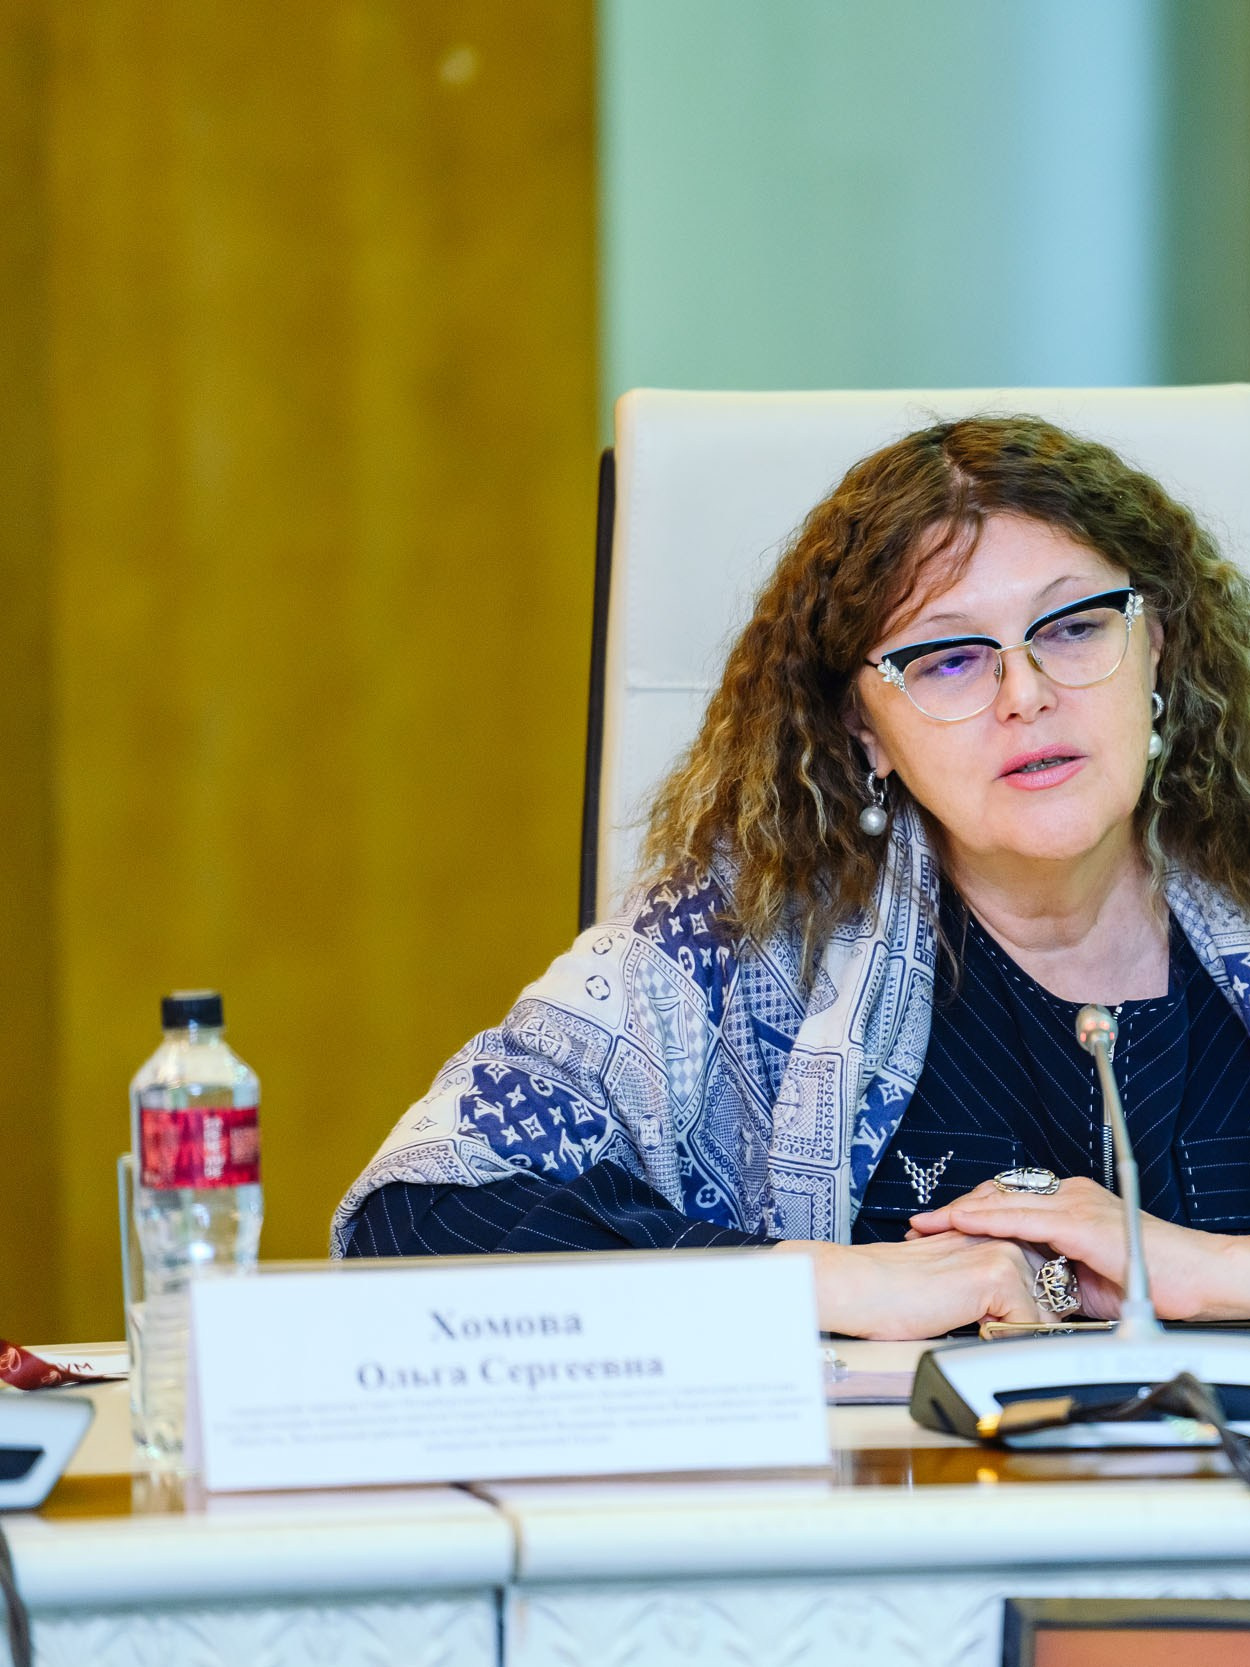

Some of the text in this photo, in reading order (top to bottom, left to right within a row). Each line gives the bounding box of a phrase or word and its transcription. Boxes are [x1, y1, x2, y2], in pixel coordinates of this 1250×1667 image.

[428, 1308, 584, 1342] Хомова
[356, 1355, 665, 1393] Ольга Сергеевна
